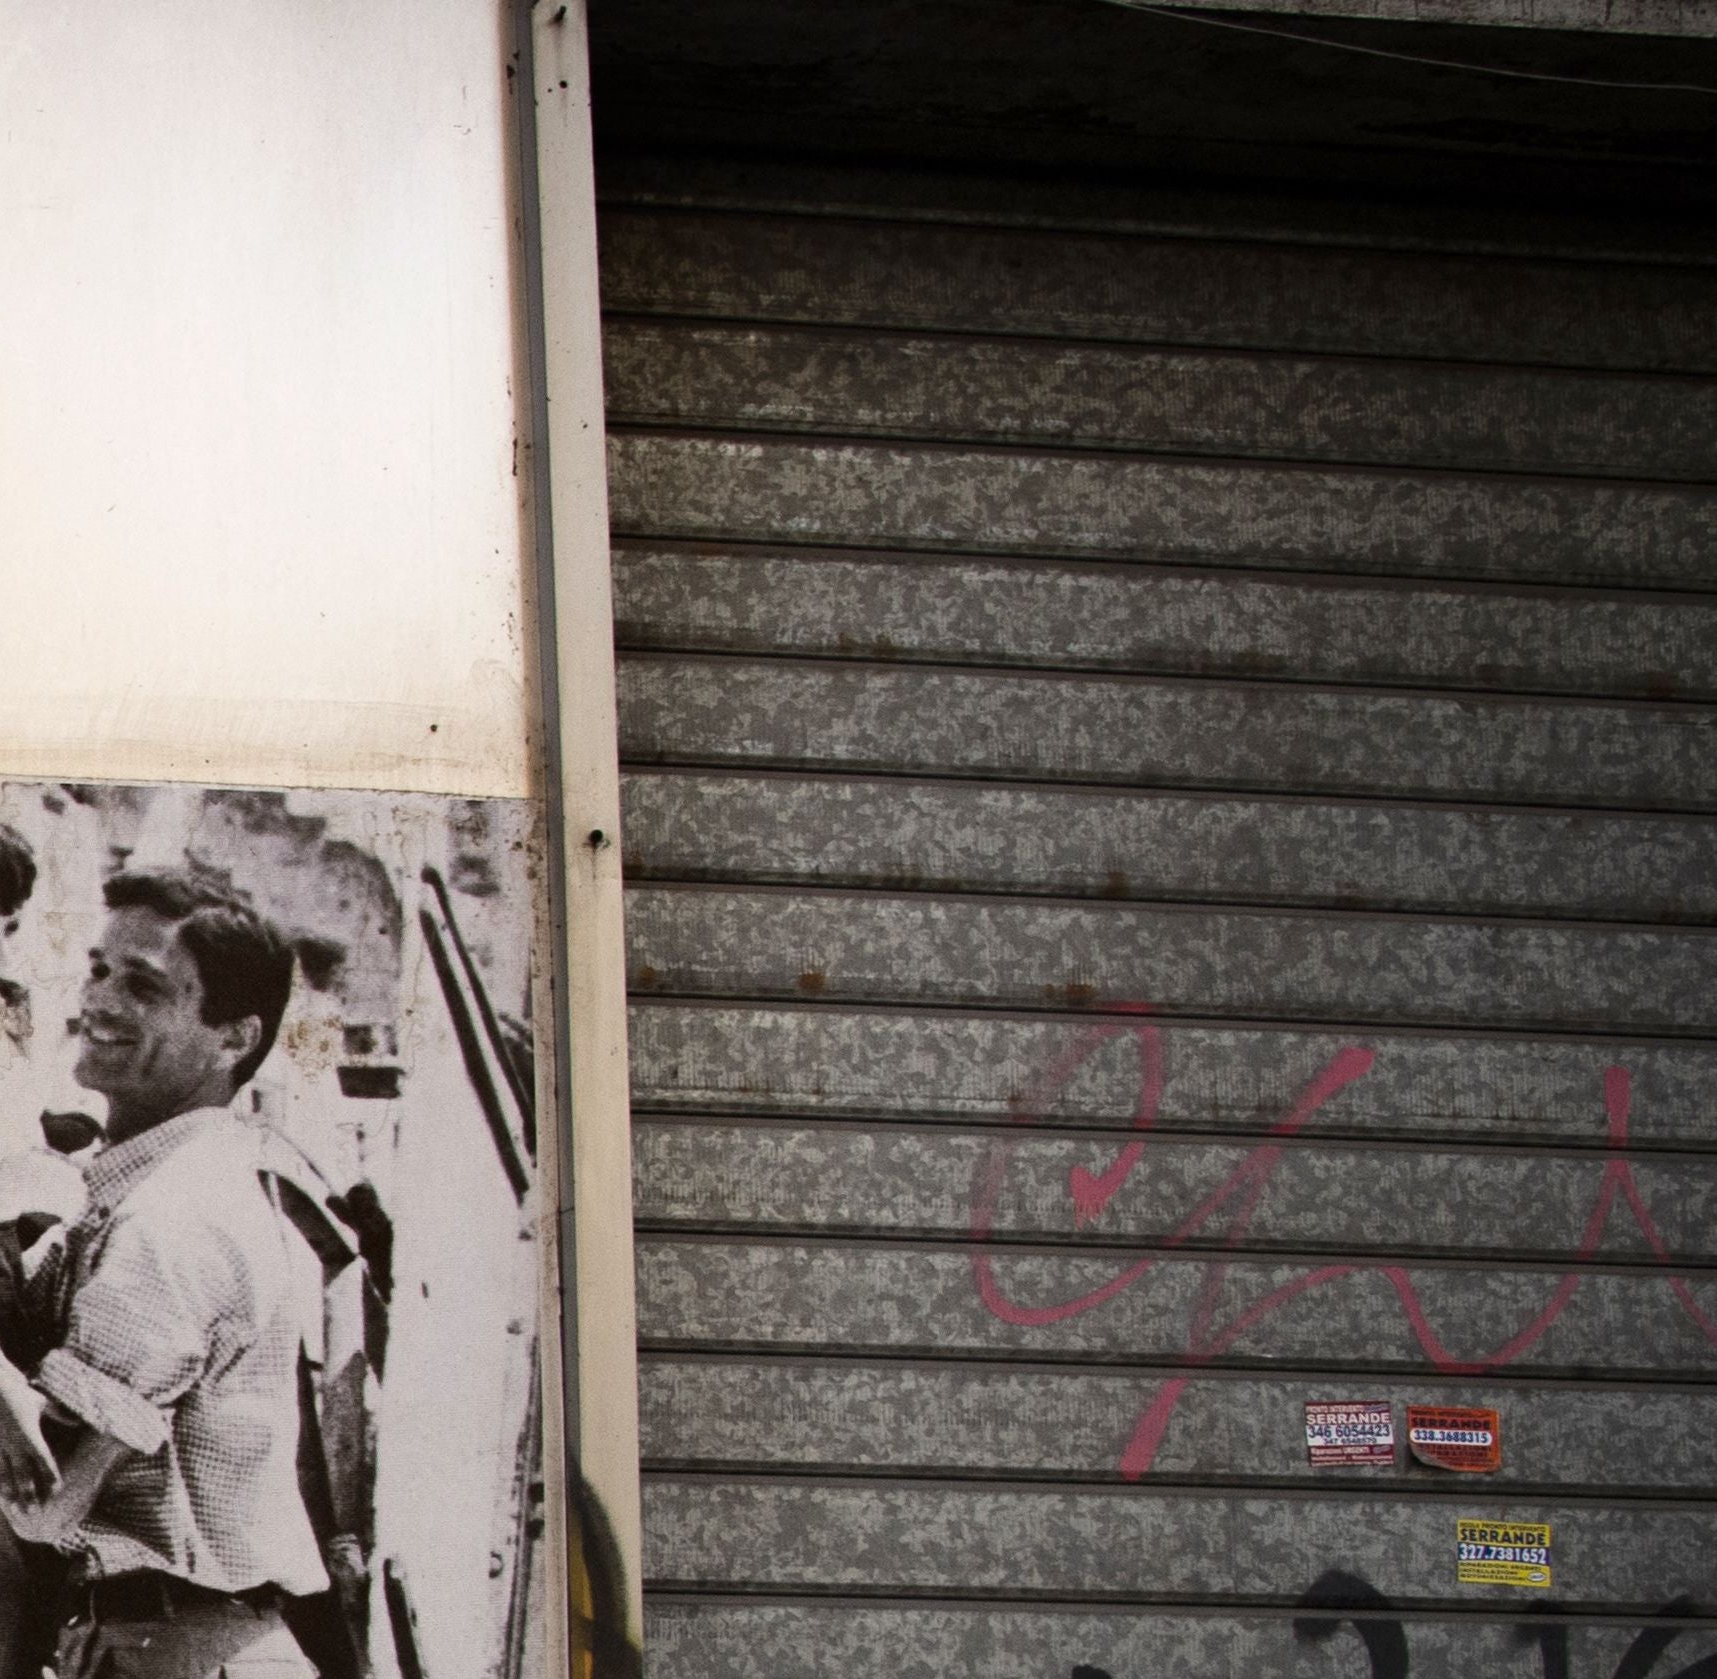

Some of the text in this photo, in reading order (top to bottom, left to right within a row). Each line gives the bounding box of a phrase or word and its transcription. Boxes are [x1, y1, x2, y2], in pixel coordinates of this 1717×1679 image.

[1306, 1411, 1391, 1425] SERRANDE
[1411, 1418, 1491, 1429] SERRANDE
[1308, 1423, 1391, 1438] 346 6054423
[1413, 1430, 1489, 1443] 338.3688315
[1460, 1528, 1546, 1546] SERRANDE
[1458, 1543, 1547, 1565] 327.7381652
